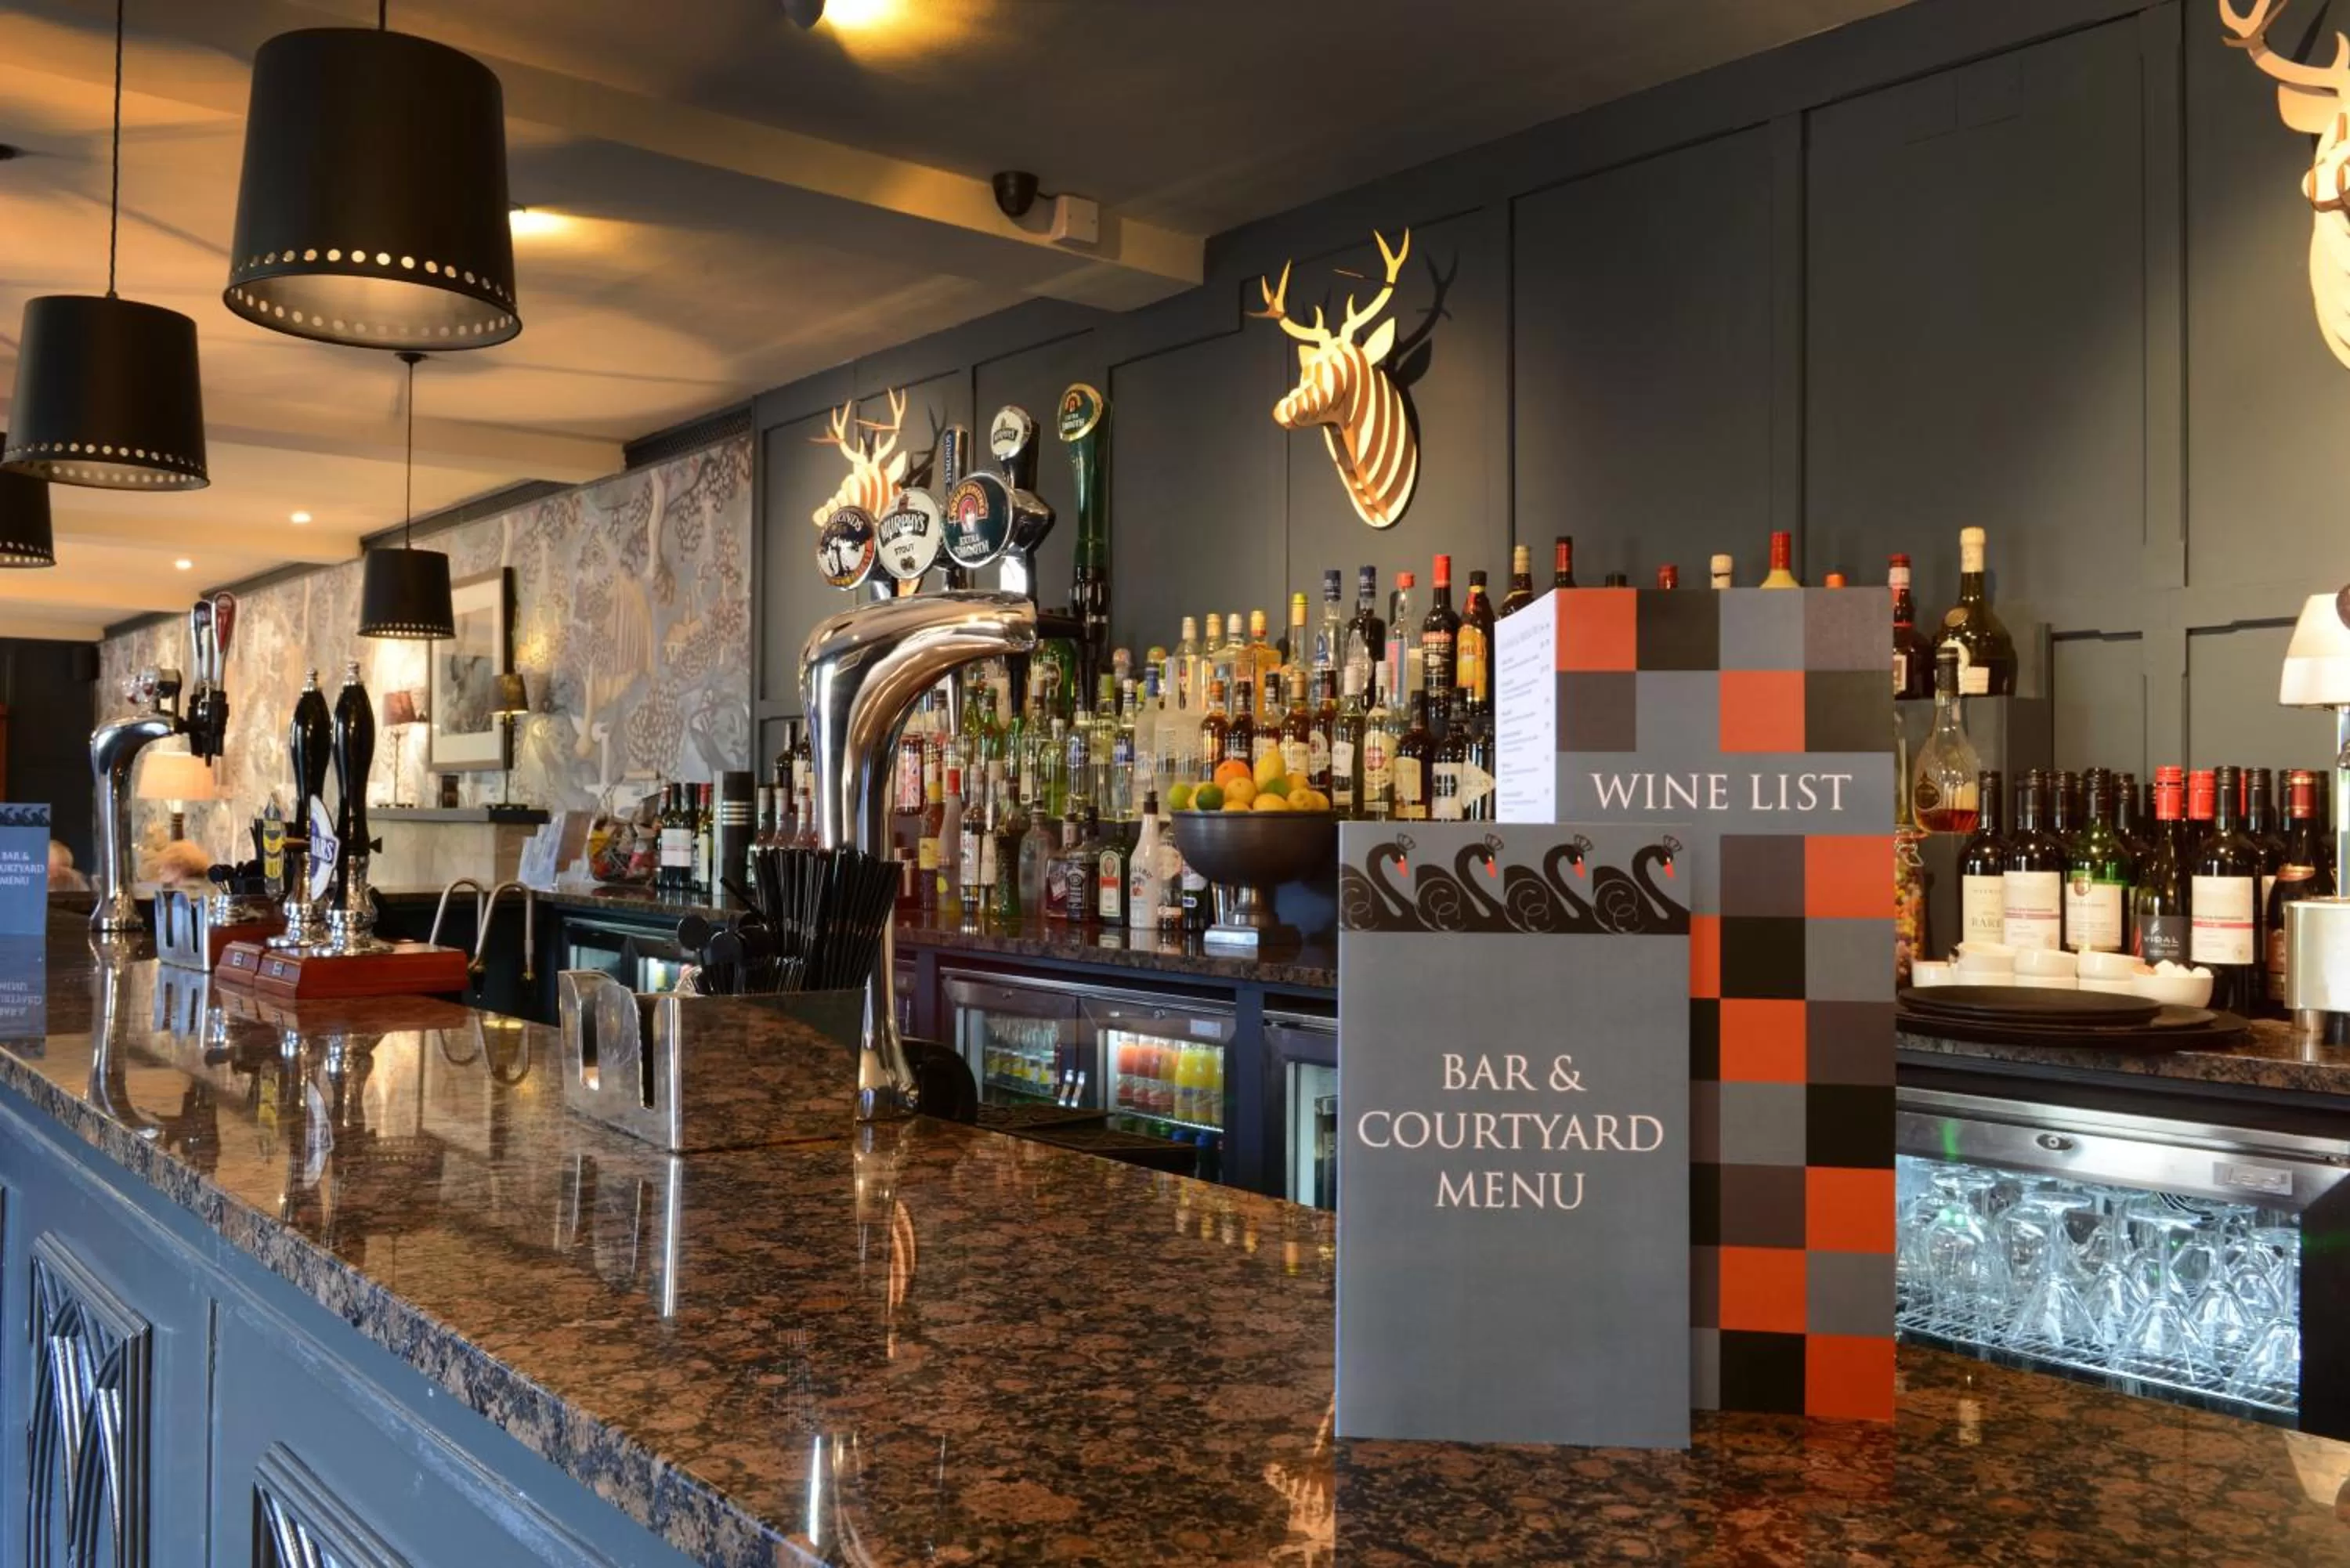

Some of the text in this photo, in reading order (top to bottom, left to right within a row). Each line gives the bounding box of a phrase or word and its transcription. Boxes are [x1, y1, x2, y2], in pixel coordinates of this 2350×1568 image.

[1589, 772, 1853, 811] WINE LIST
[2144, 936, 2179, 945] VIDAL
[1442, 1053, 1587, 1092] BAR &
[1358, 1111, 1665, 1152] COURTYARD
[1435, 1170, 1586, 1210] MENU
